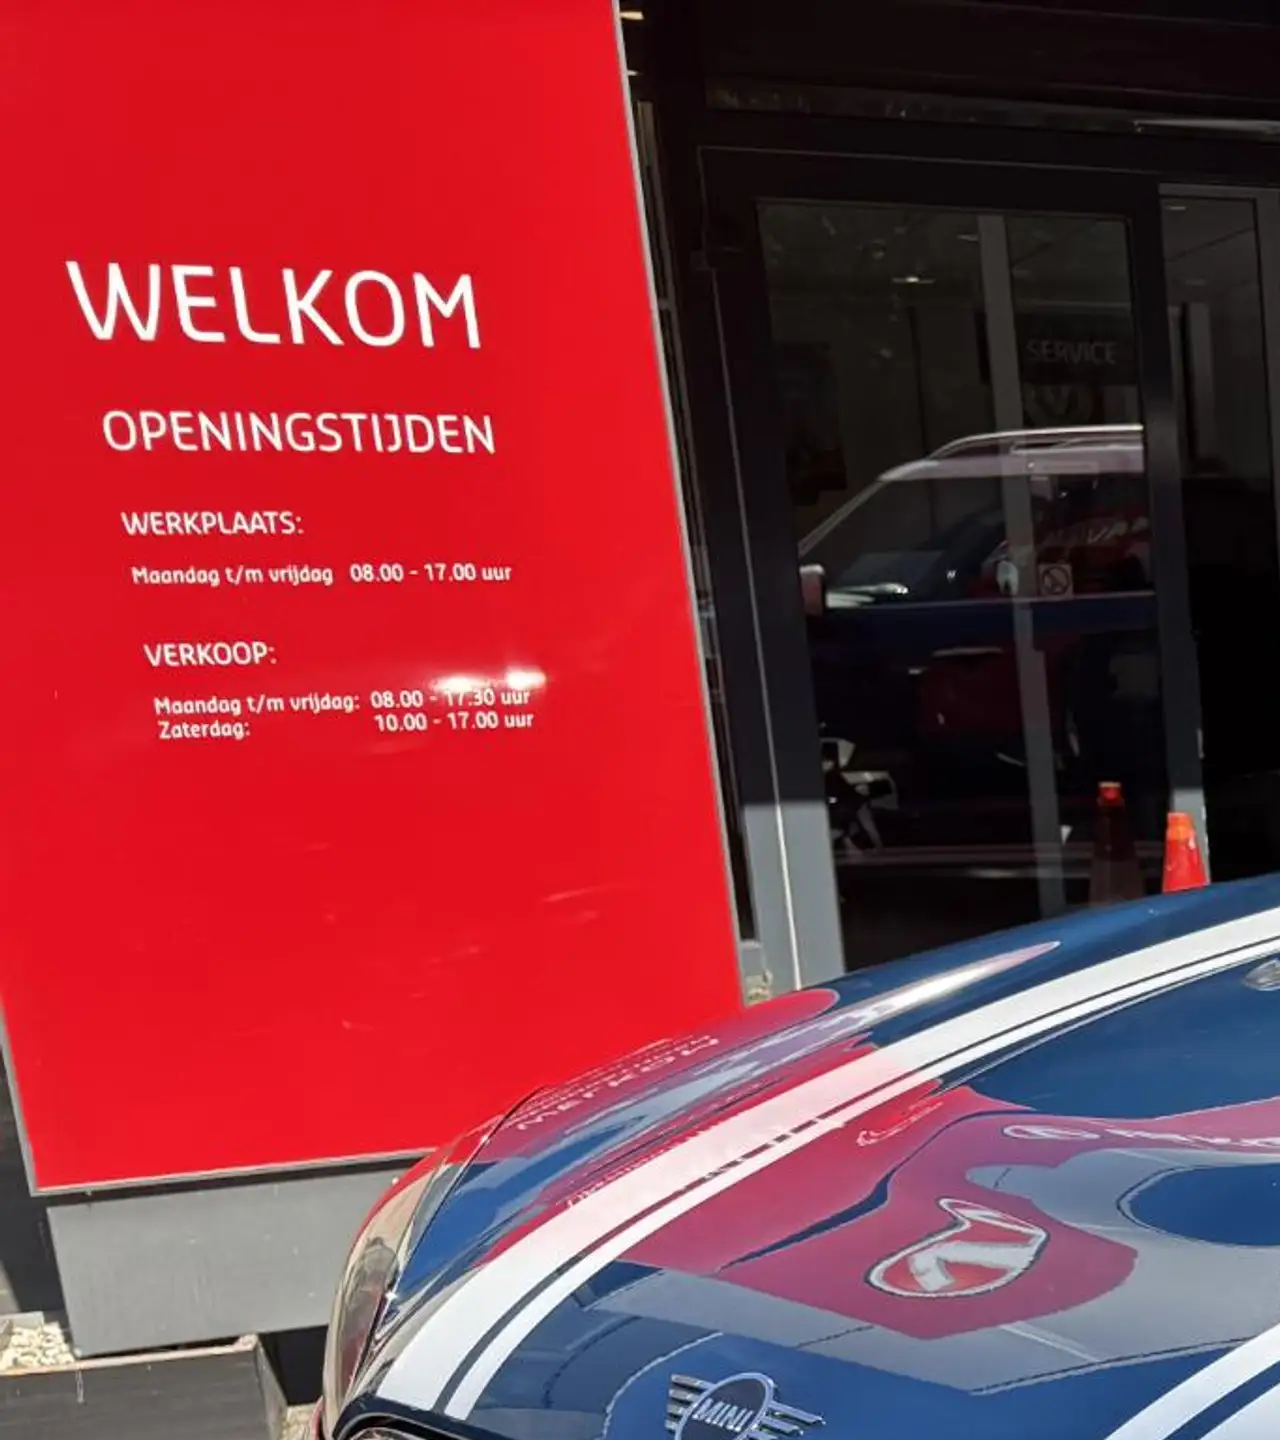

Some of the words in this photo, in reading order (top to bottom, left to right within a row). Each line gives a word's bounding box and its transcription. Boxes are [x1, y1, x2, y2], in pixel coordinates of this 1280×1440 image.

[65, 260, 482, 350] WELKOM
[1025, 338, 1118, 366] SERVICE
[102, 409, 497, 455] OPENINGSTIJDEN
[120, 510, 304, 536] WERKPLAATS:
[131, 564, 220, 587] Maandag
[224, 564, 264, 585] t/m
[268, 564, 334, 586] vrijdag
[350, 562, 404, 584] 08.00
[423, 562, 477, 582] 17.00
[481, 565, 513, 582] uur
[143, 640, 277, 667] VERKOOP:
[153, 696, 241, 717] Maandag
[246, 694, 285, 714] t/m
[289, 692, 361, 714] vrijdag:
[369, 690, 424, 710] 08.00
[443, 688, 496, 708] 17.30
[500, 690, 531, 706] uur
[157, 719, 251, 741] Zaterdag:
[374, 711, 428, 733] 10.00
[447, 710, 499, 731] 17.00
[503, 712, 535, 729] uur
[690, 1397, 754, 1433] MINI
